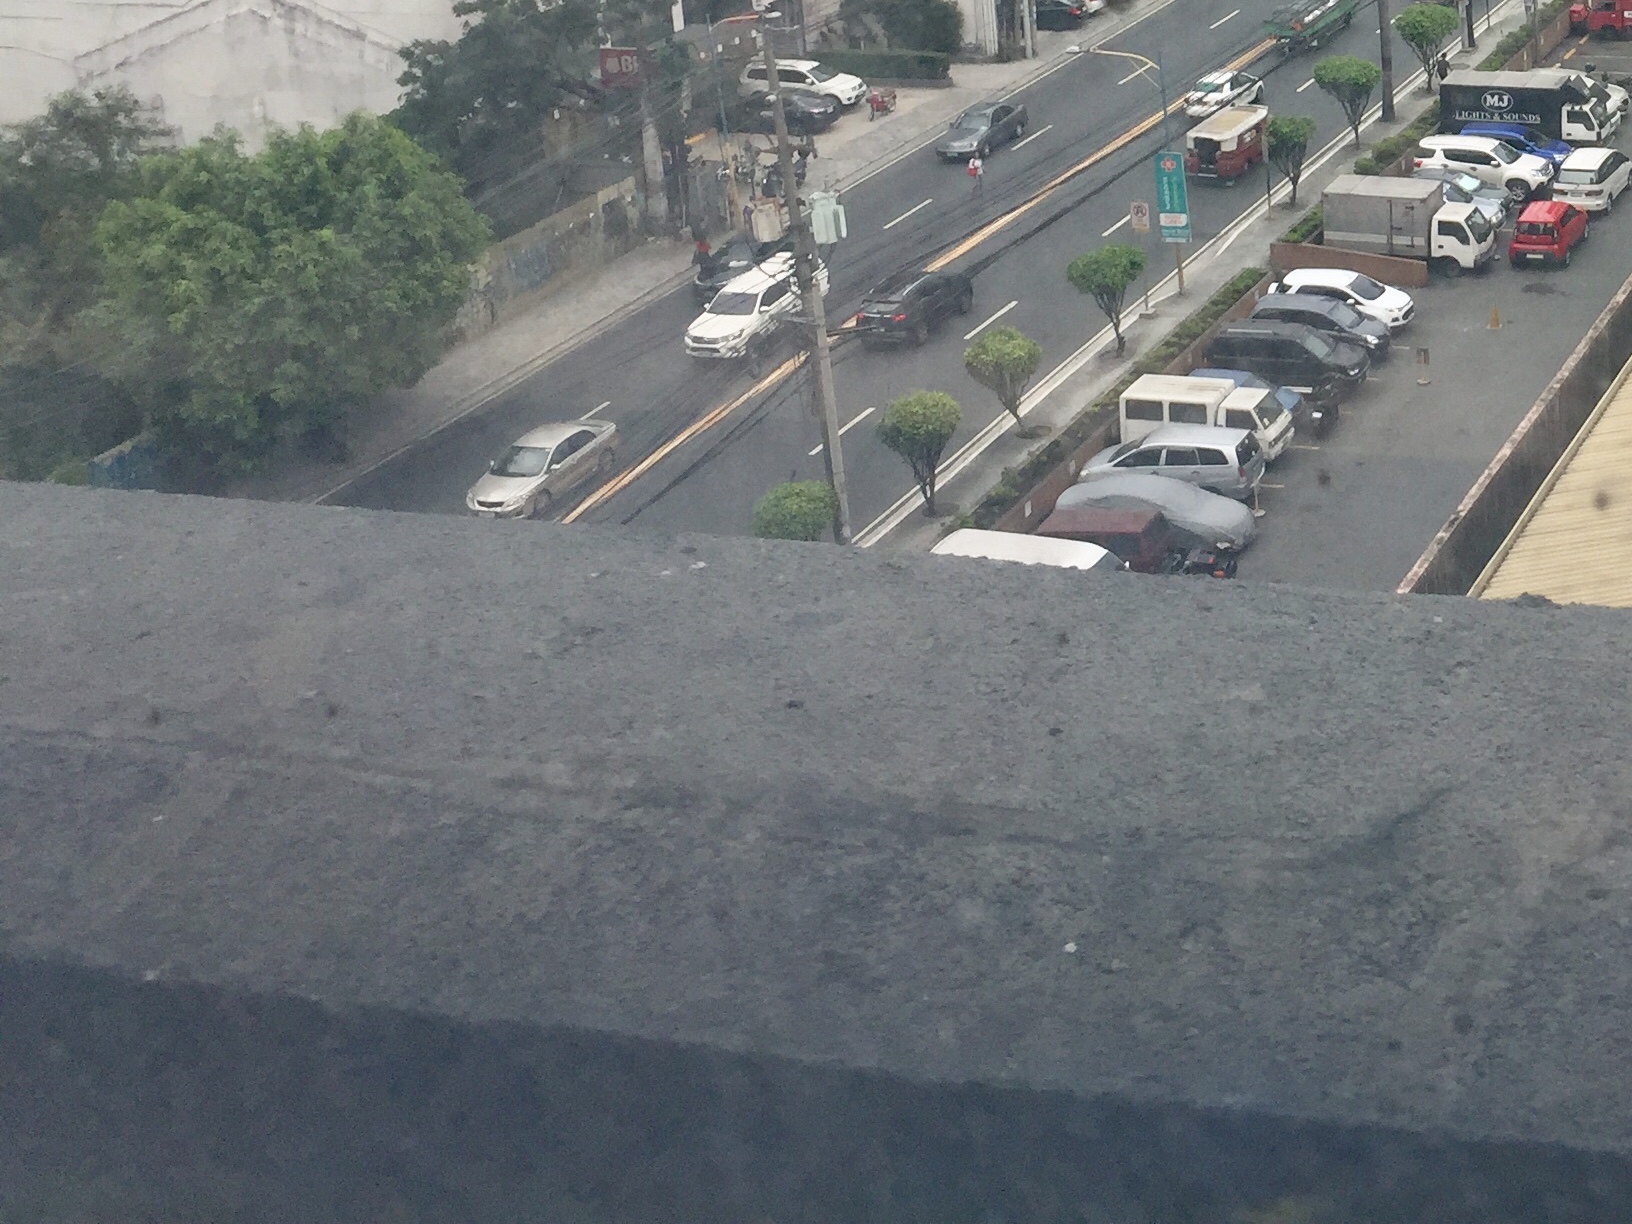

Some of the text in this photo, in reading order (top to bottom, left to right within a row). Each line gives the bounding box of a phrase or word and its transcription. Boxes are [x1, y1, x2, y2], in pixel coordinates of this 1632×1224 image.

[1485, 94, 1509, 107] MJ
[1455, 110, 1491, 120] LIGHTS
[1503, 113, 1540, 122] SOUNDS
